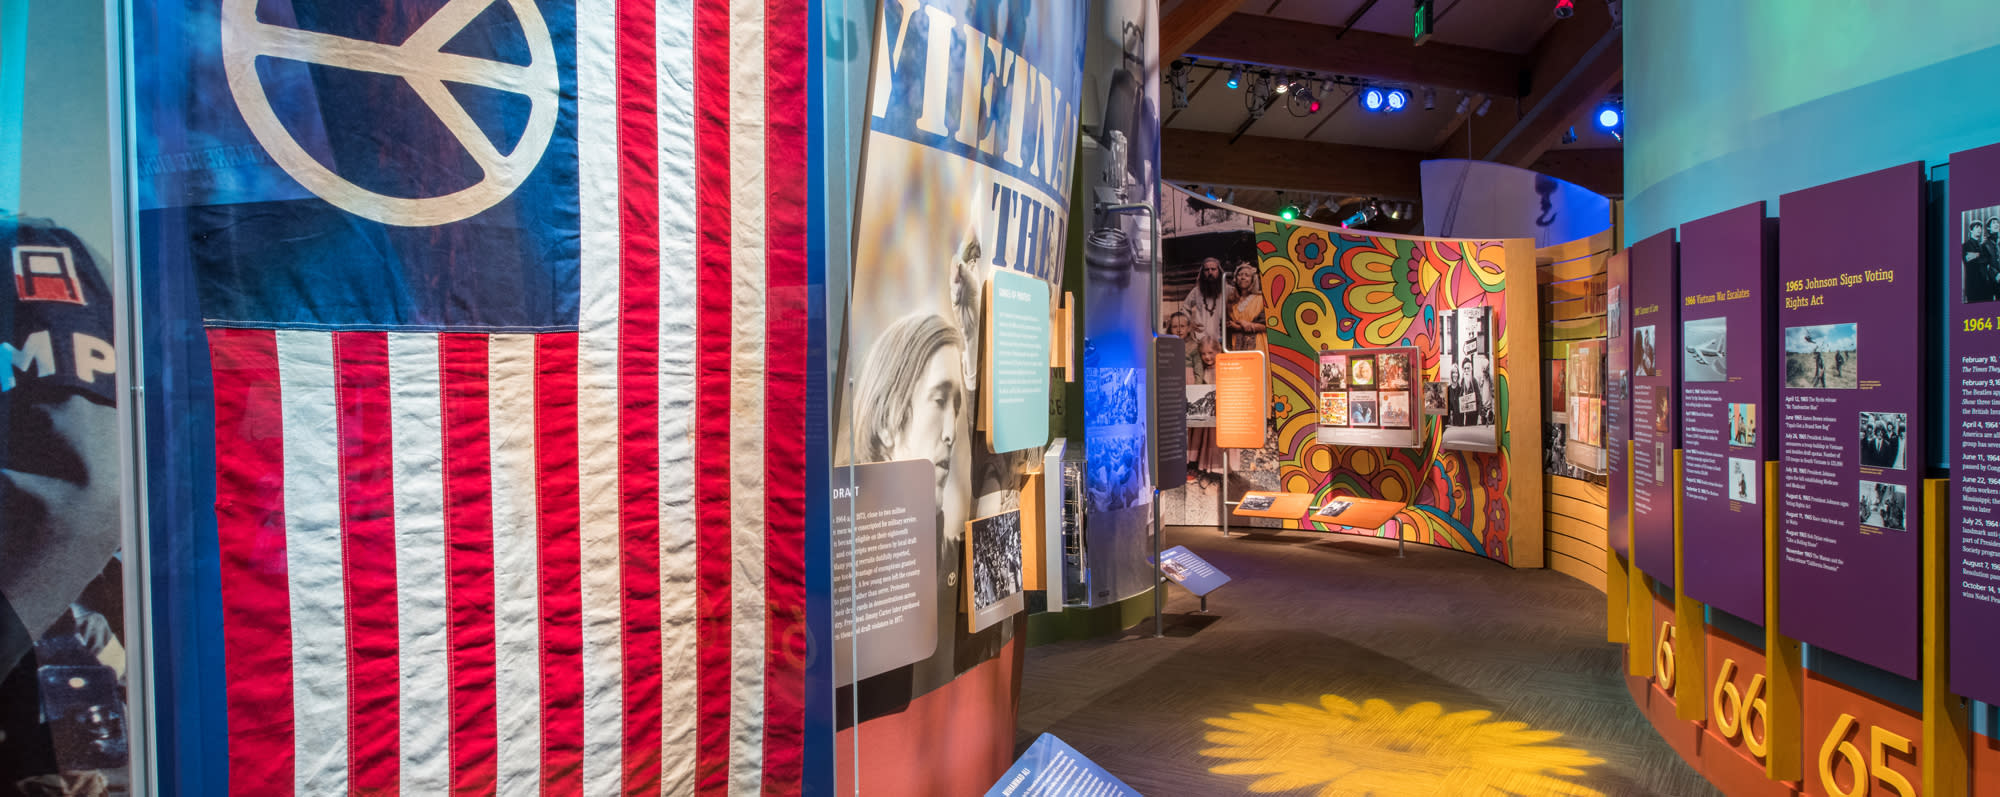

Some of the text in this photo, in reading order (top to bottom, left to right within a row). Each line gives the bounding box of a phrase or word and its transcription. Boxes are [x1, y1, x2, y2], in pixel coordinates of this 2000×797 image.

[992, 182, 1054, 280] THE
[1786, 269, 1893, 292] 1965 Johnson Signs Voting
[1685, 289, 1750, 305] 1966 Vietnam War Escalates
[1786, 294, 1824, 310] Rights Act
[1963, 318, 1992, 332] 1964
[1962, 356, 1988, 364] February
[1962, 379, 1988, 387] February
[833, 486, 859, 499] DRAT
[888, 518, 903, 527] military
[1962, 517, 1974, 526] July
[1974, 518, 1983, 526] 25,
[1962, 527, 1986, 536] landmark
[1962, 545, 1980, 555] Society
[1962, 559, 1983, 568] August
[1962, 568, 1989, 578] Resolution
[1962, 581, 1986, 591] October
[1975, 592, 1989, 602] Nobel
[1657, 621, 1676, 690] 6
[1819, 714, 1916, 797] 65
